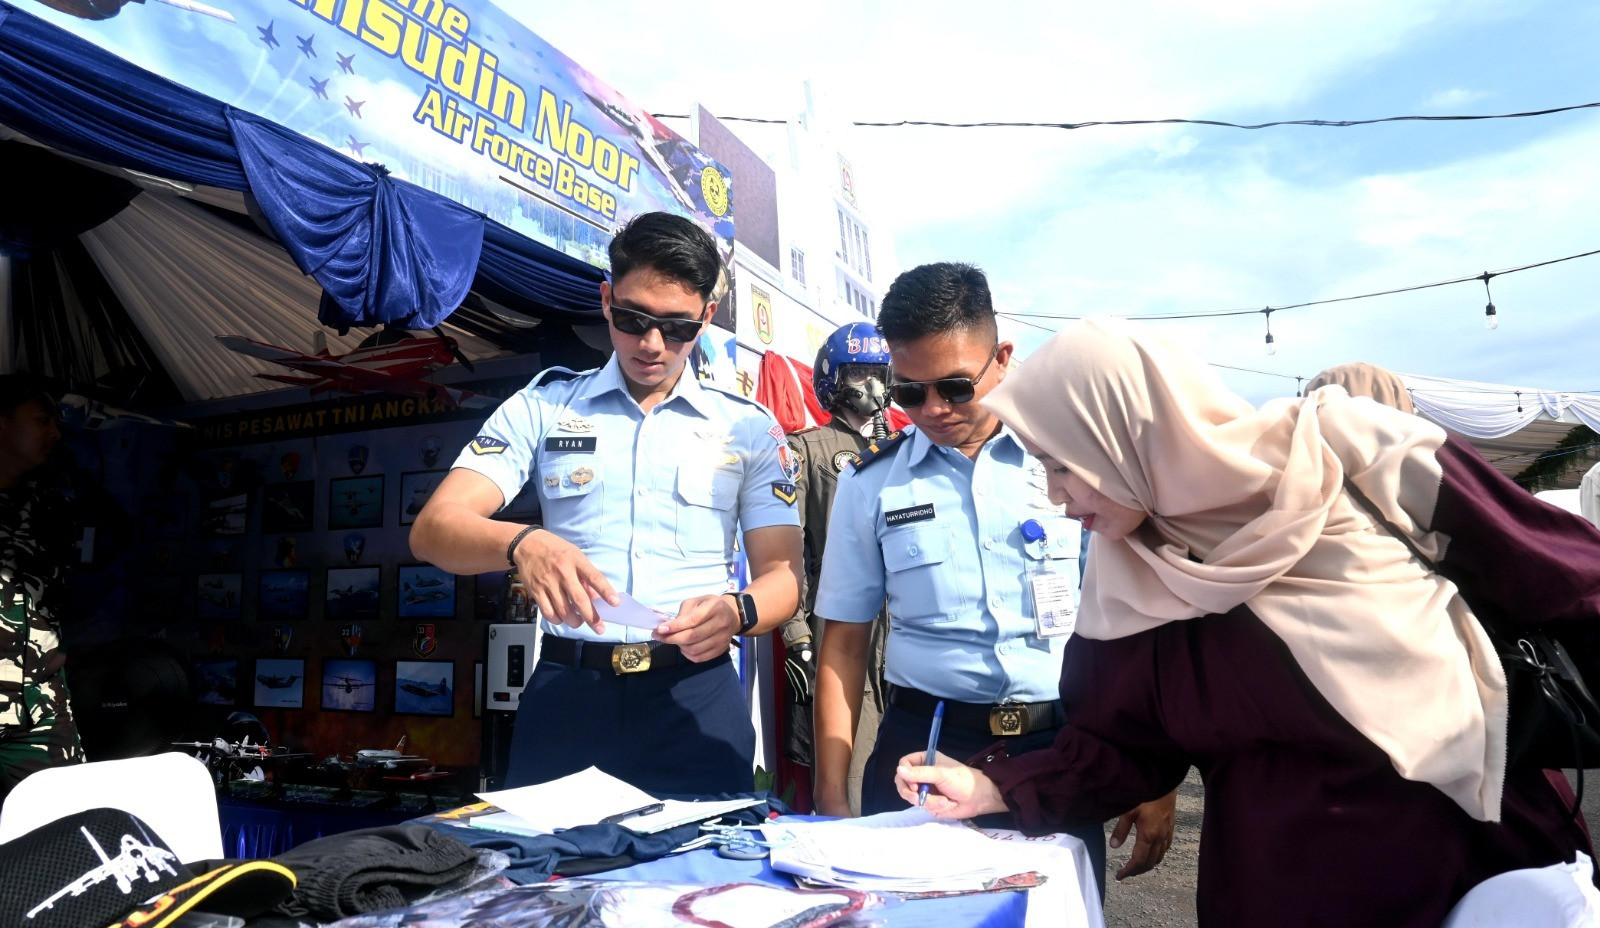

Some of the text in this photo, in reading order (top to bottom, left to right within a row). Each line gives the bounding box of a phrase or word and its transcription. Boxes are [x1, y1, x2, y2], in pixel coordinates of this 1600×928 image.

[536, 88, 639, 188] Noor
[416, 87, 616, 216] Air Force Base
[239, 410, 325, 437] PESAWAT
[332, 404, 367, 425] TNI
[480, 437, 496, 446] TNI
[558, 440, 583, 448] RYAN
[886, 507, 933, 522] HAYATURRIDHO
